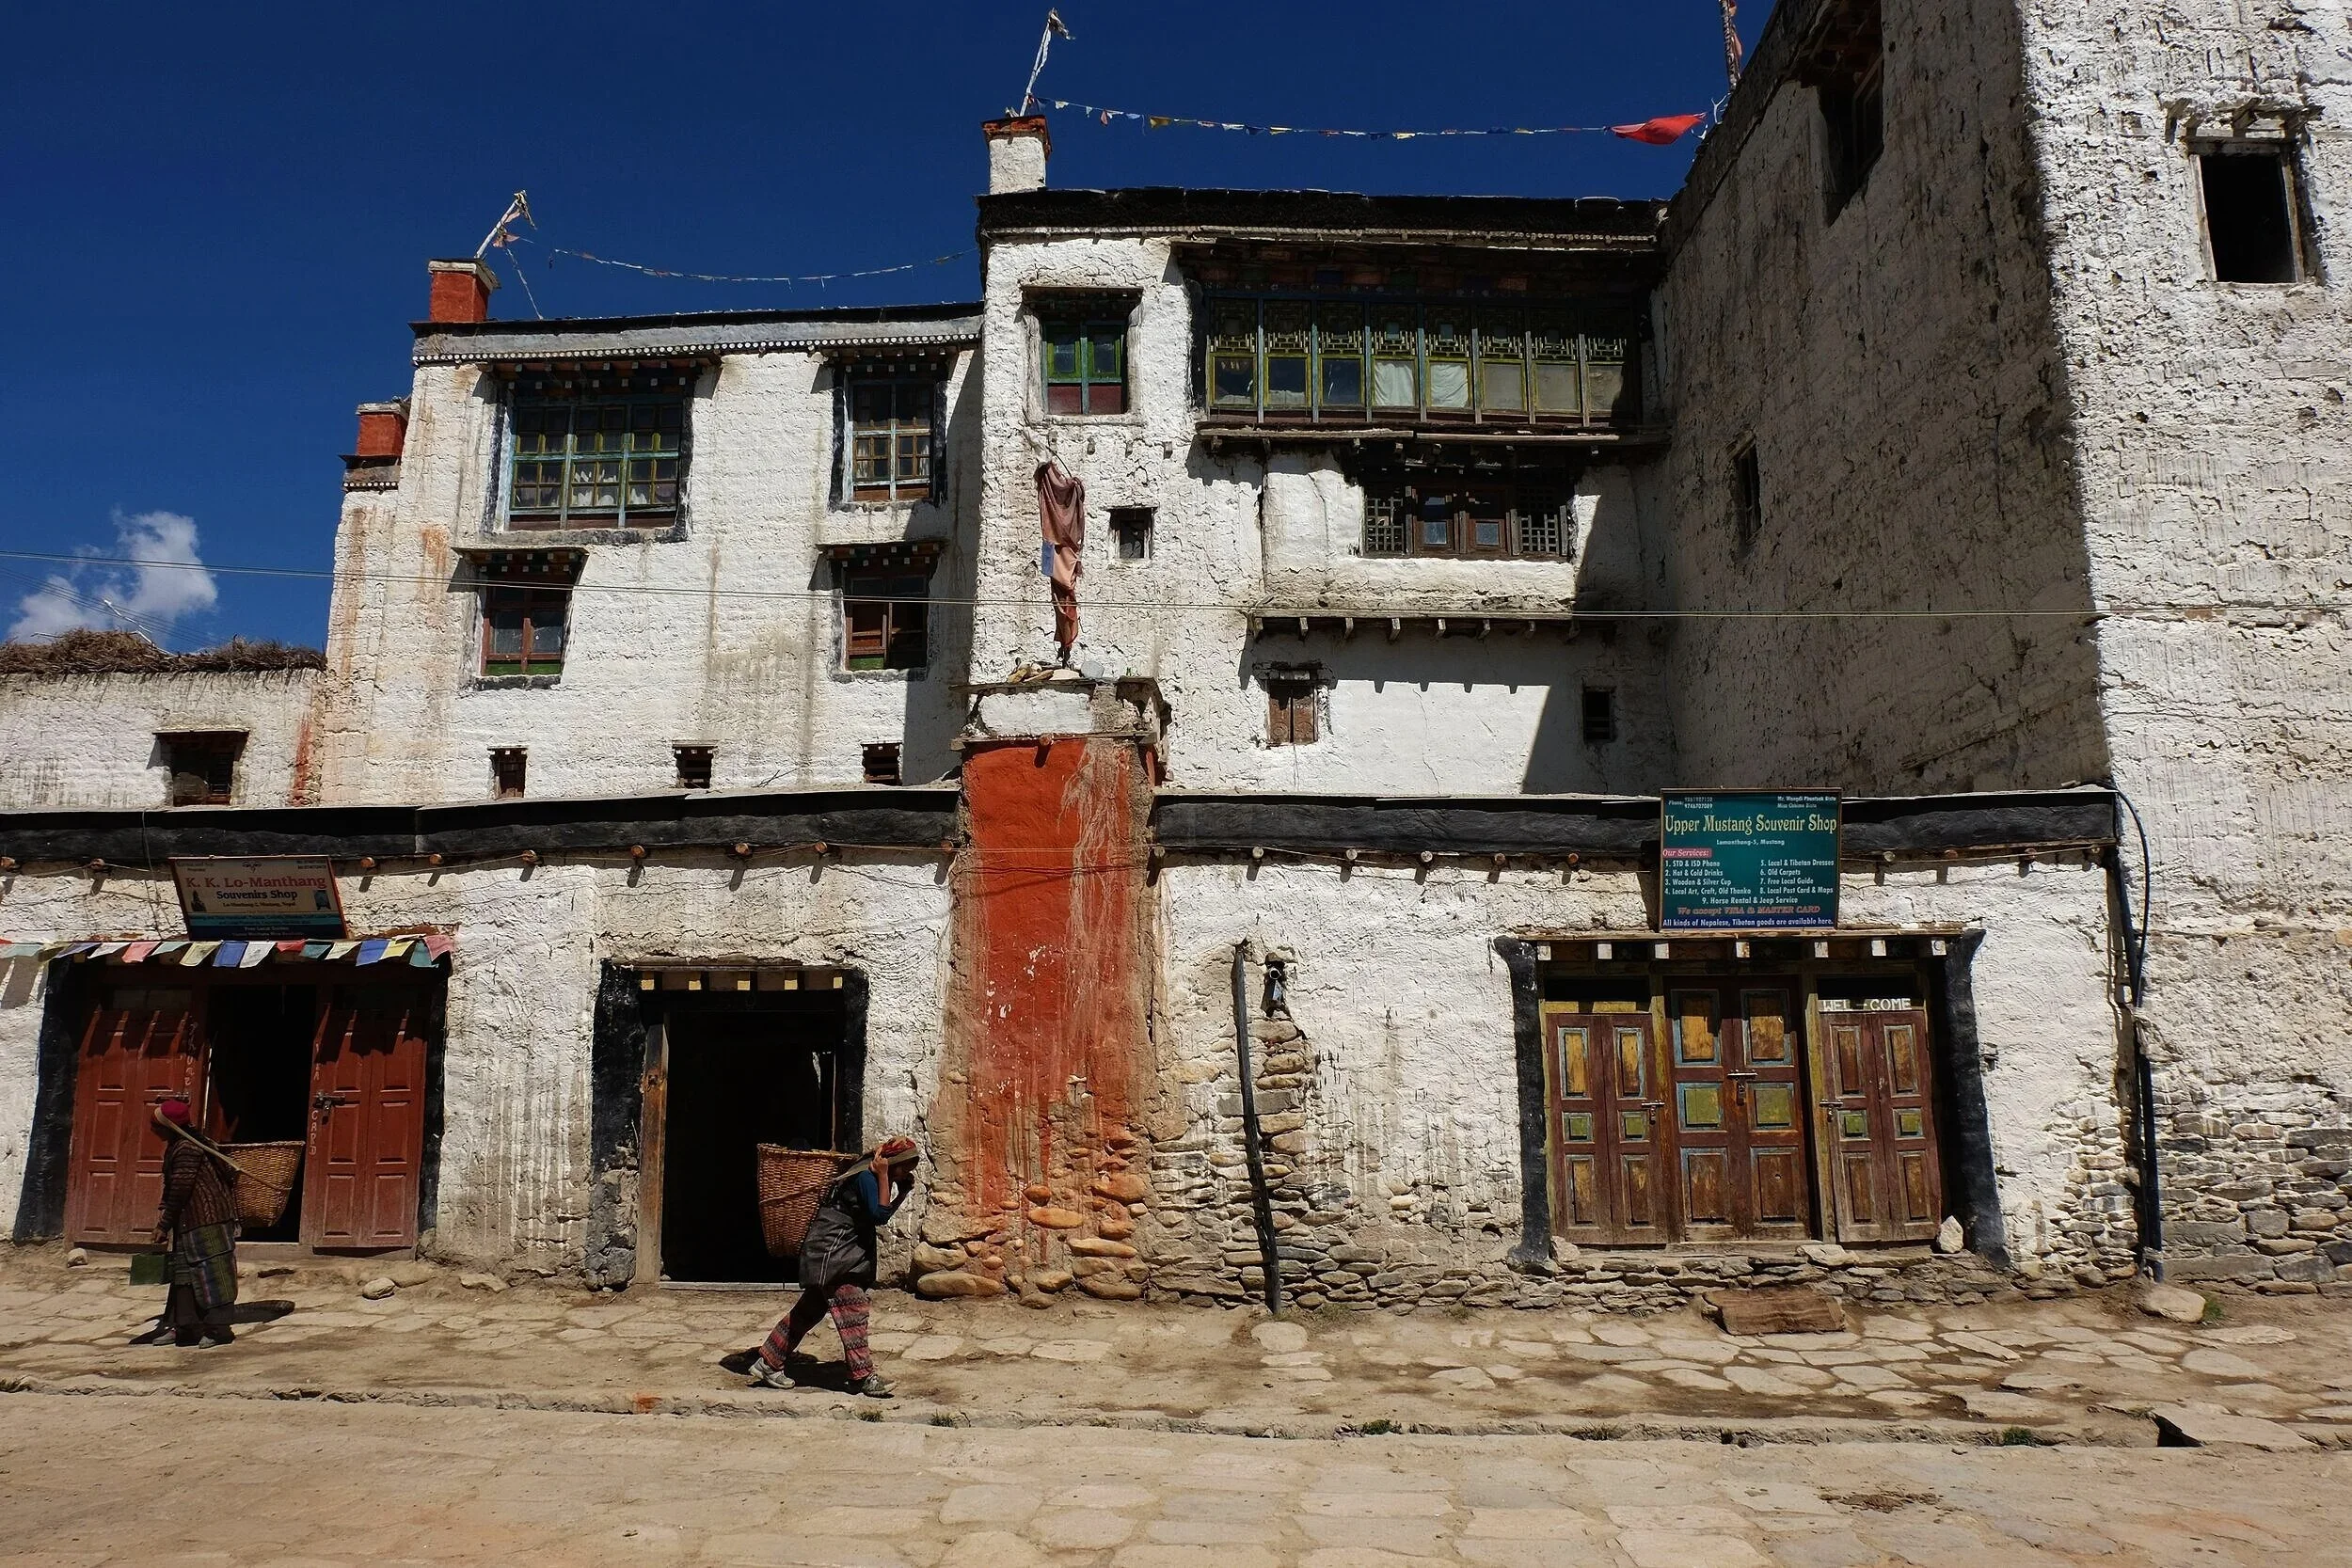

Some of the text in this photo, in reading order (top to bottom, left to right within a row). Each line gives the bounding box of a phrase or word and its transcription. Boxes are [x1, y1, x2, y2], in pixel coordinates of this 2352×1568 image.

[1665, 814, 1836, 835] Upper Mustang Souvenir Shop
[1662, 848, 1709, 857] Our Services:
[185, 876, 327, 889] K. K. Lo-Manthang
[217, 890, 297, 901] Souvenirs Shop
[1759, 896, 1774, 905] Jeep
[1692, 908, 1722, 916] accept
[1757, 906, 1794, 914] MASTER
[1700, 919, 1730, 927] Nepalese,
[1756, 918, 1774, 927] goods
[309, 1110, 319, 1156] CARD
